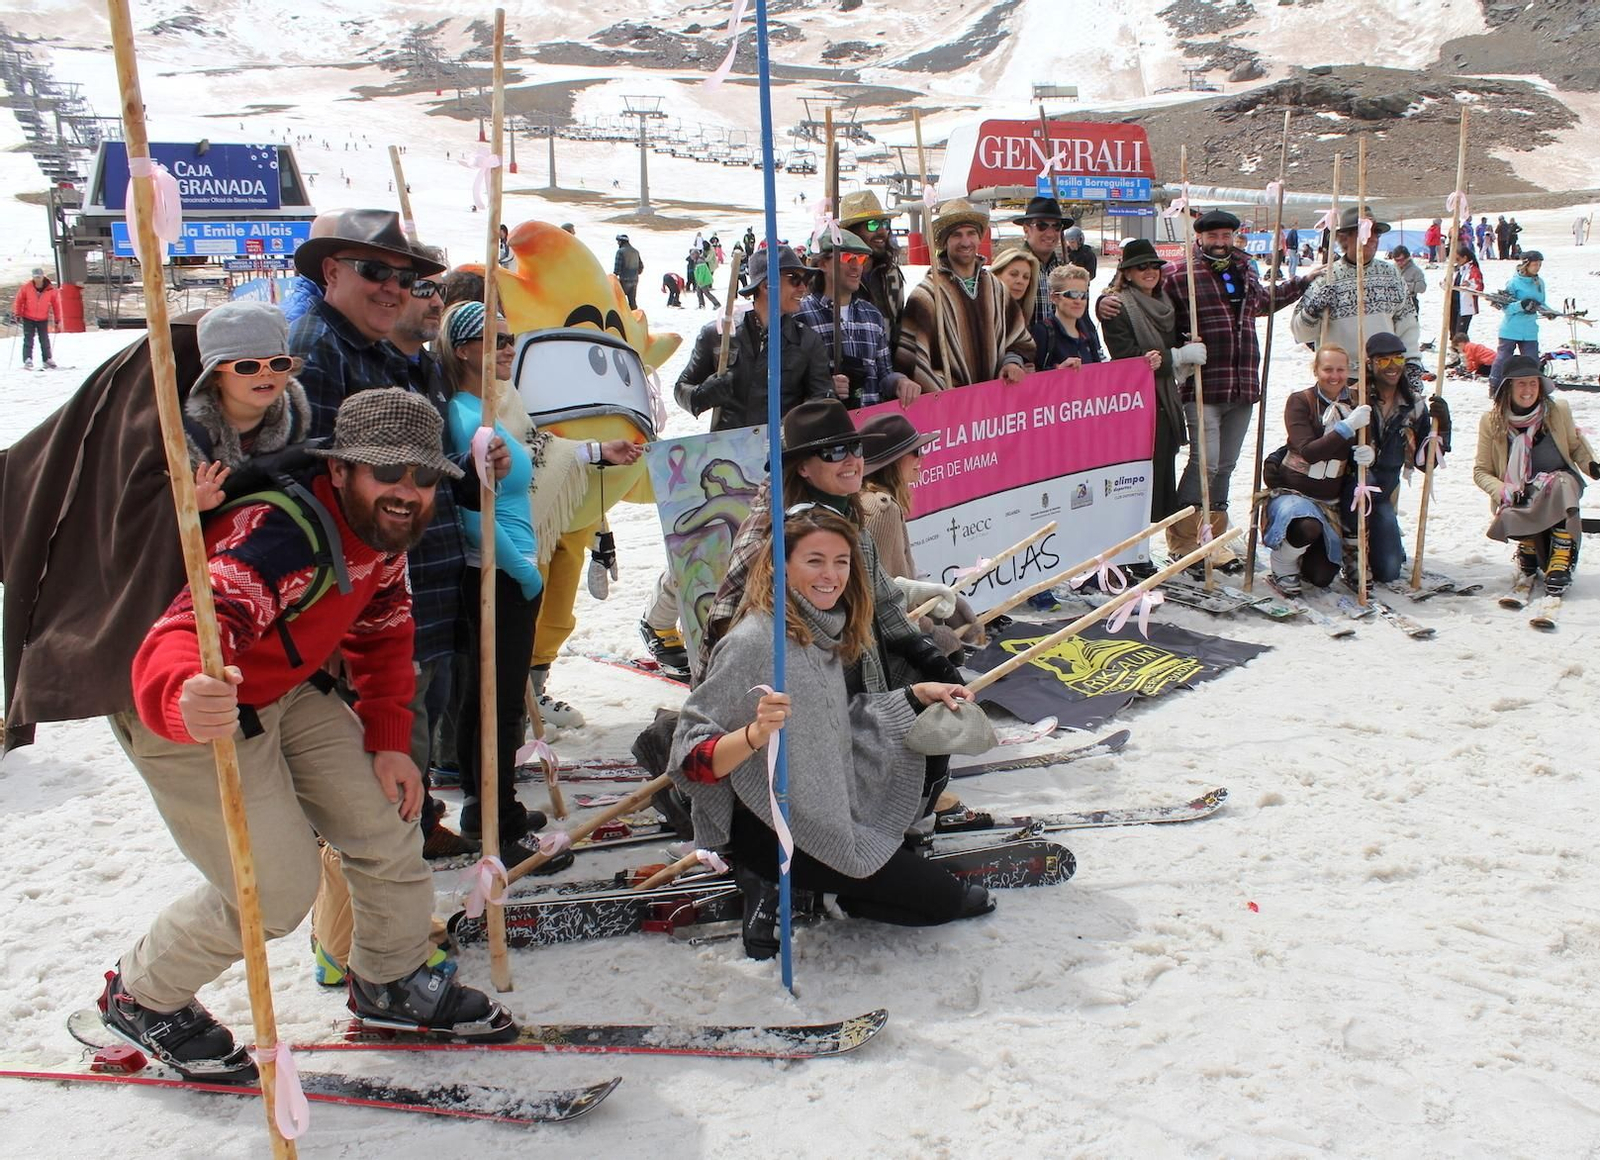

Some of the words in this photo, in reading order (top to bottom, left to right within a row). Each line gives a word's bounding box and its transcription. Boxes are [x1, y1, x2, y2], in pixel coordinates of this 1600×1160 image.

[979, 135, 1144, 173] GENERALI
[178, 179, 267, 196] GRANADA
[1047, 176, 1082, 187] Tlesilla
[1085, 178, 1134, 188] Borreguiles
[203, 224, 245, 237] Emile
[250, 224, 293, 237] Allais
[946, 424, 968, 448] LA
[972, 411, 1027, 442] MUJER
[1033, 406, 1056, 429] EN
[1059, 391, 1145, 423] GRANADA
[947, 460, 962, 477] DE
[964, 452, 998, 472] MAMA
[1114, 475, 1145, 486] olimpo
[962, 517, 992, 538] aecc
